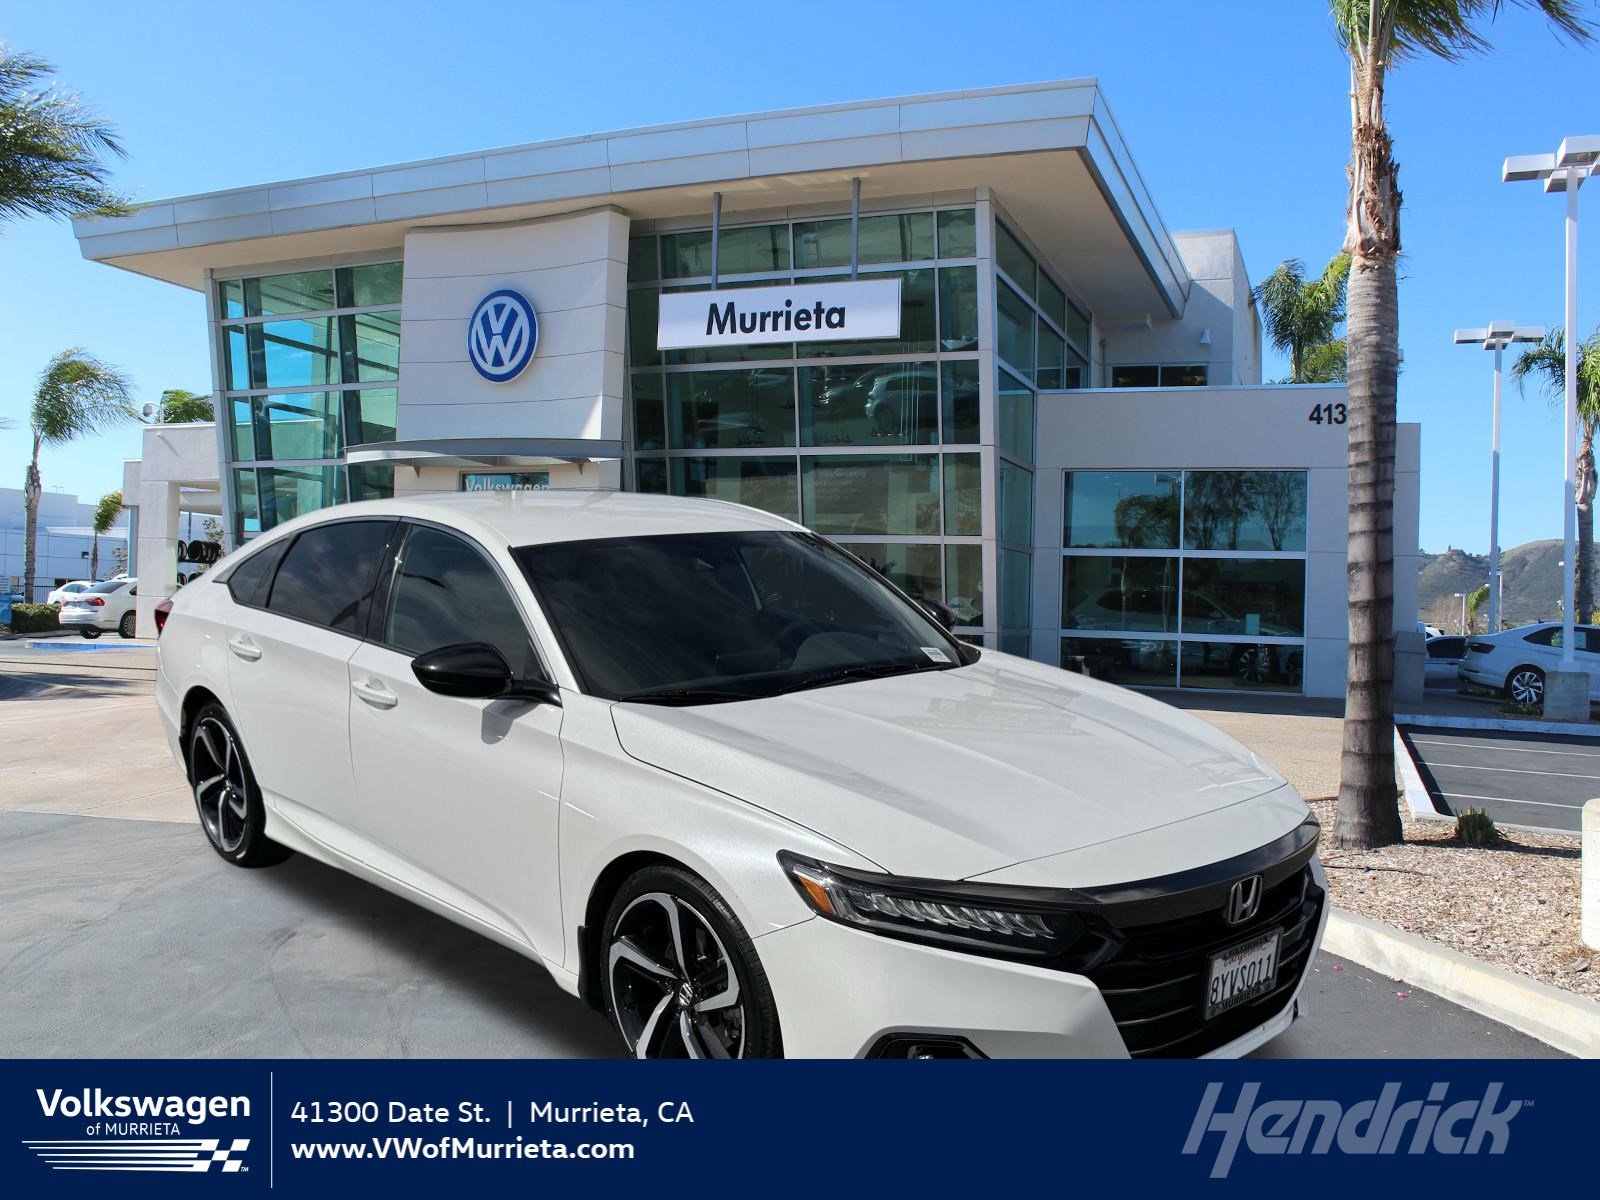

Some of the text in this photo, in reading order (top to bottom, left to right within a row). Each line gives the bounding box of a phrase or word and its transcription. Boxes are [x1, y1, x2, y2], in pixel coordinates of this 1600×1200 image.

[706, 299, 846, 336] Murrieta
[1308, 403, 1347, 425] 413
[1210, 953, 1272, 1006] 8YVS011
